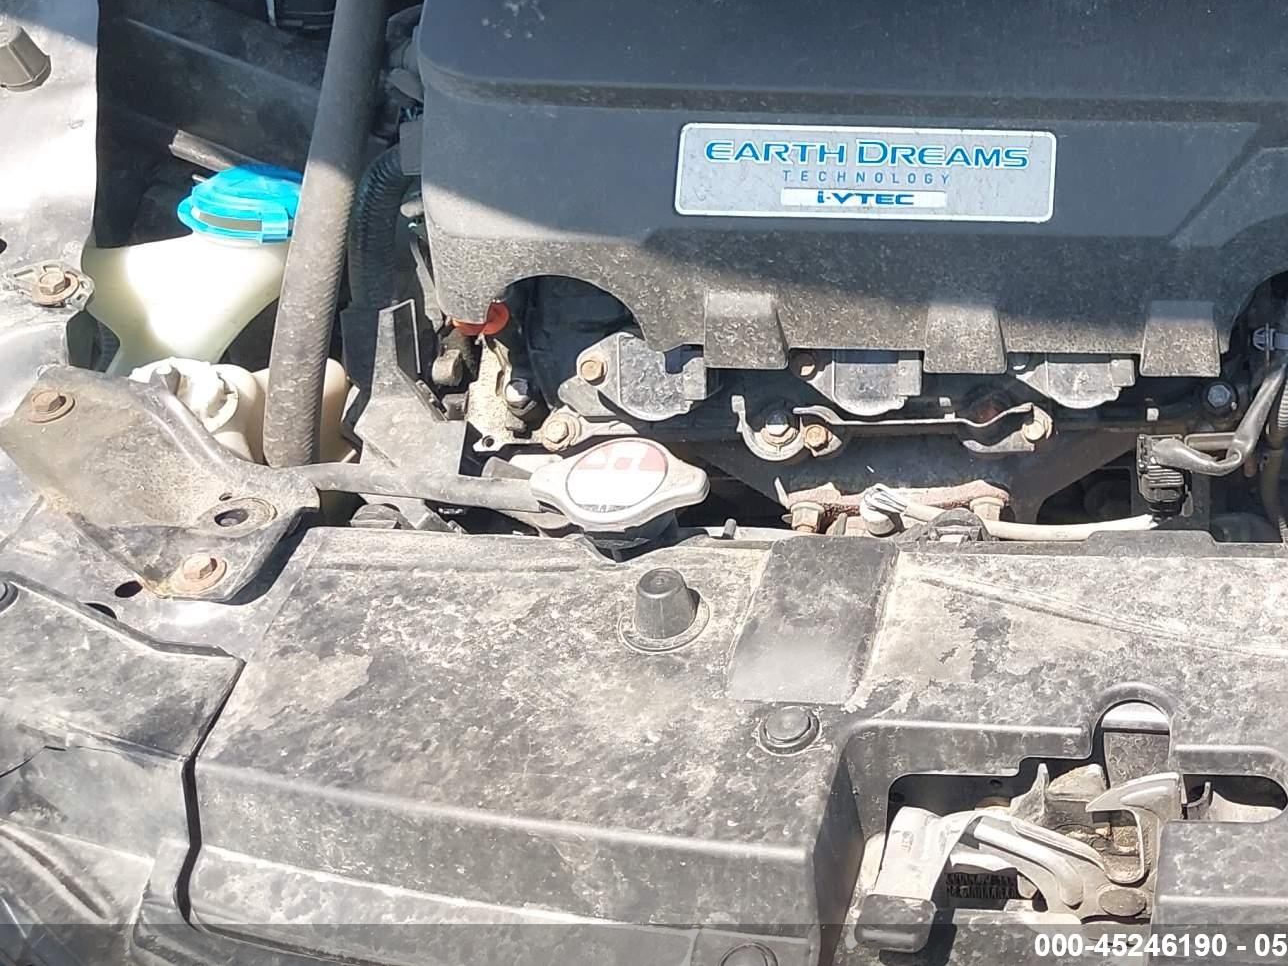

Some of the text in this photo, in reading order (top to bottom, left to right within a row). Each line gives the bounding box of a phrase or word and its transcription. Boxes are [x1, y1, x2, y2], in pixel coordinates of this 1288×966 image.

[705, 139, 1029, 168] EARTH DREAMS
[782, 169, 950, 185] TECHNOLOGY
[816, 190, 915, 206] i-VTEC
